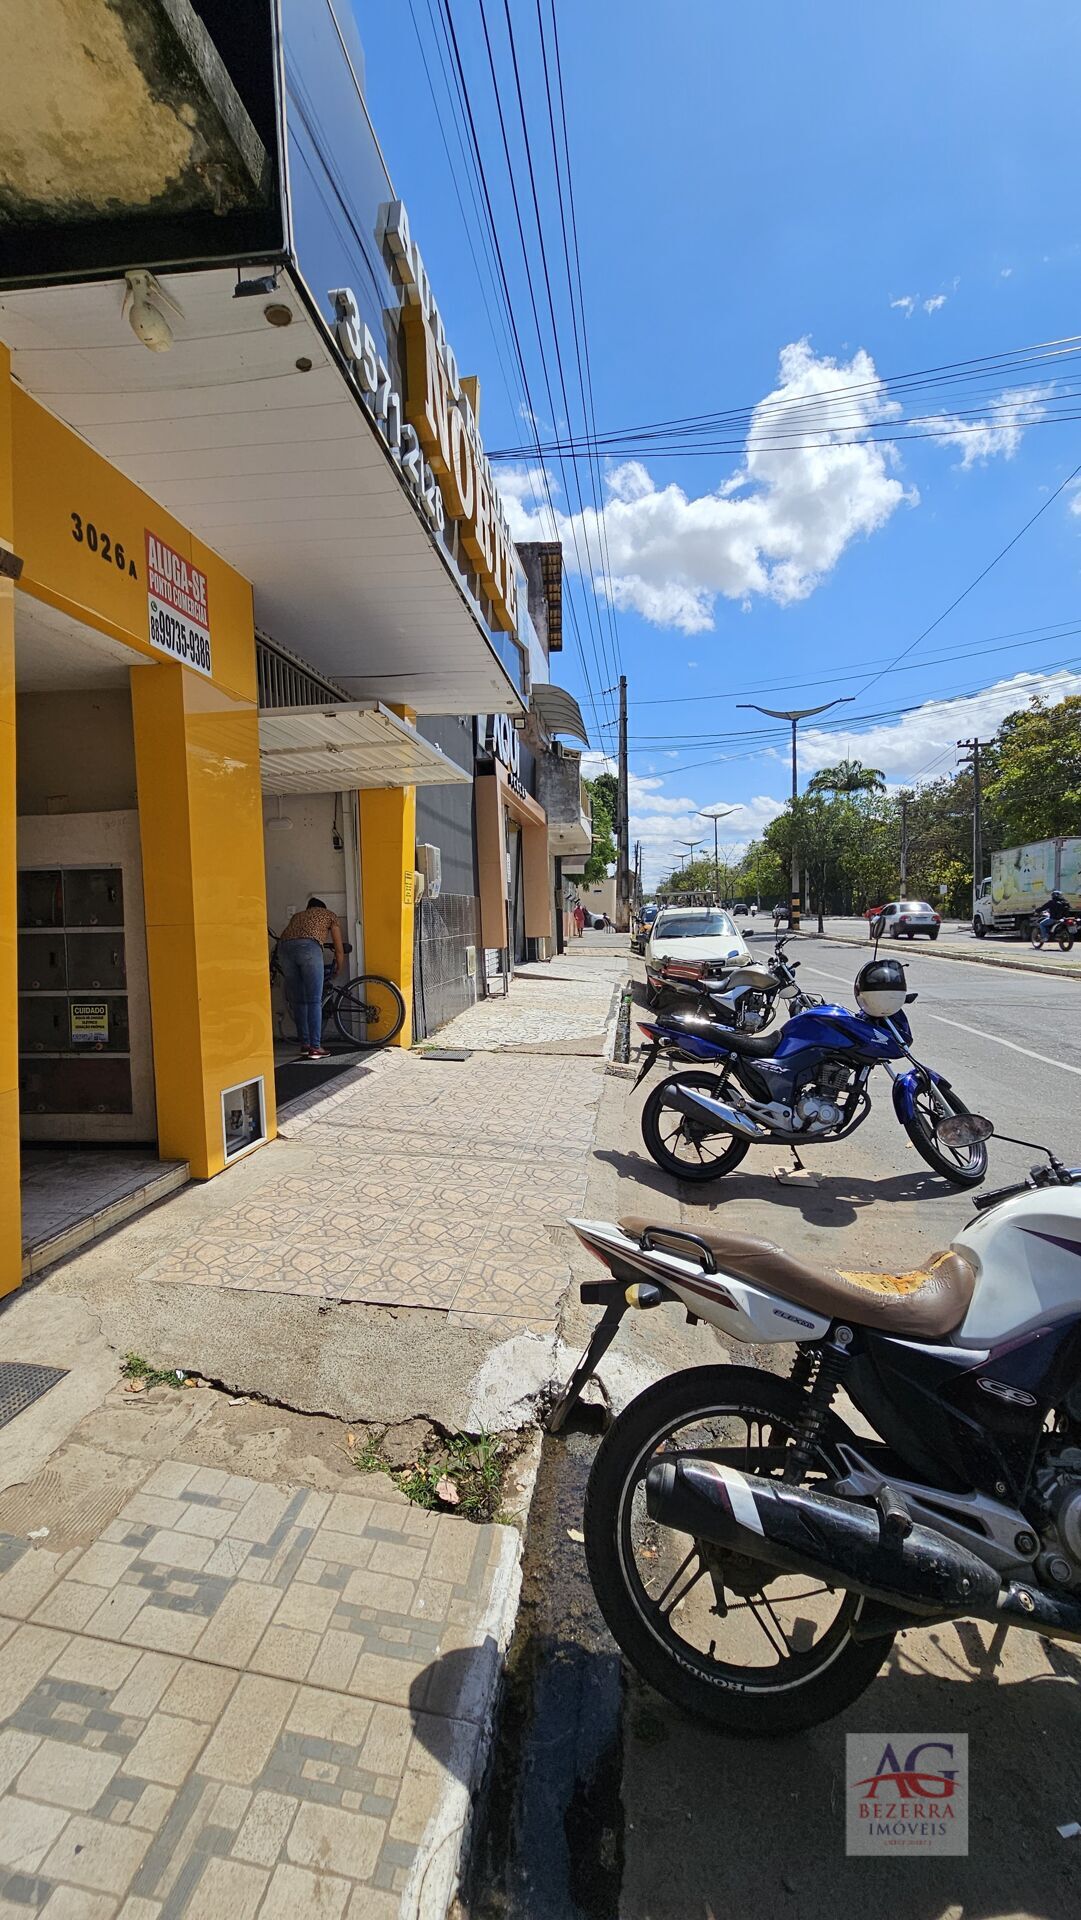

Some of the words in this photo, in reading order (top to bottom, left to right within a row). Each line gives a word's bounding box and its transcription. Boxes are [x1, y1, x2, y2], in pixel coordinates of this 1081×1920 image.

[406, 312, 518, 632] NORTE
[148, 536, 207, 607] ALUGA-SE
[149, 569, 172, 603] PONTO
[173, 586, 208, 627] COMERCIAL
[75, 1007, 105, 1015] CUIDADO
